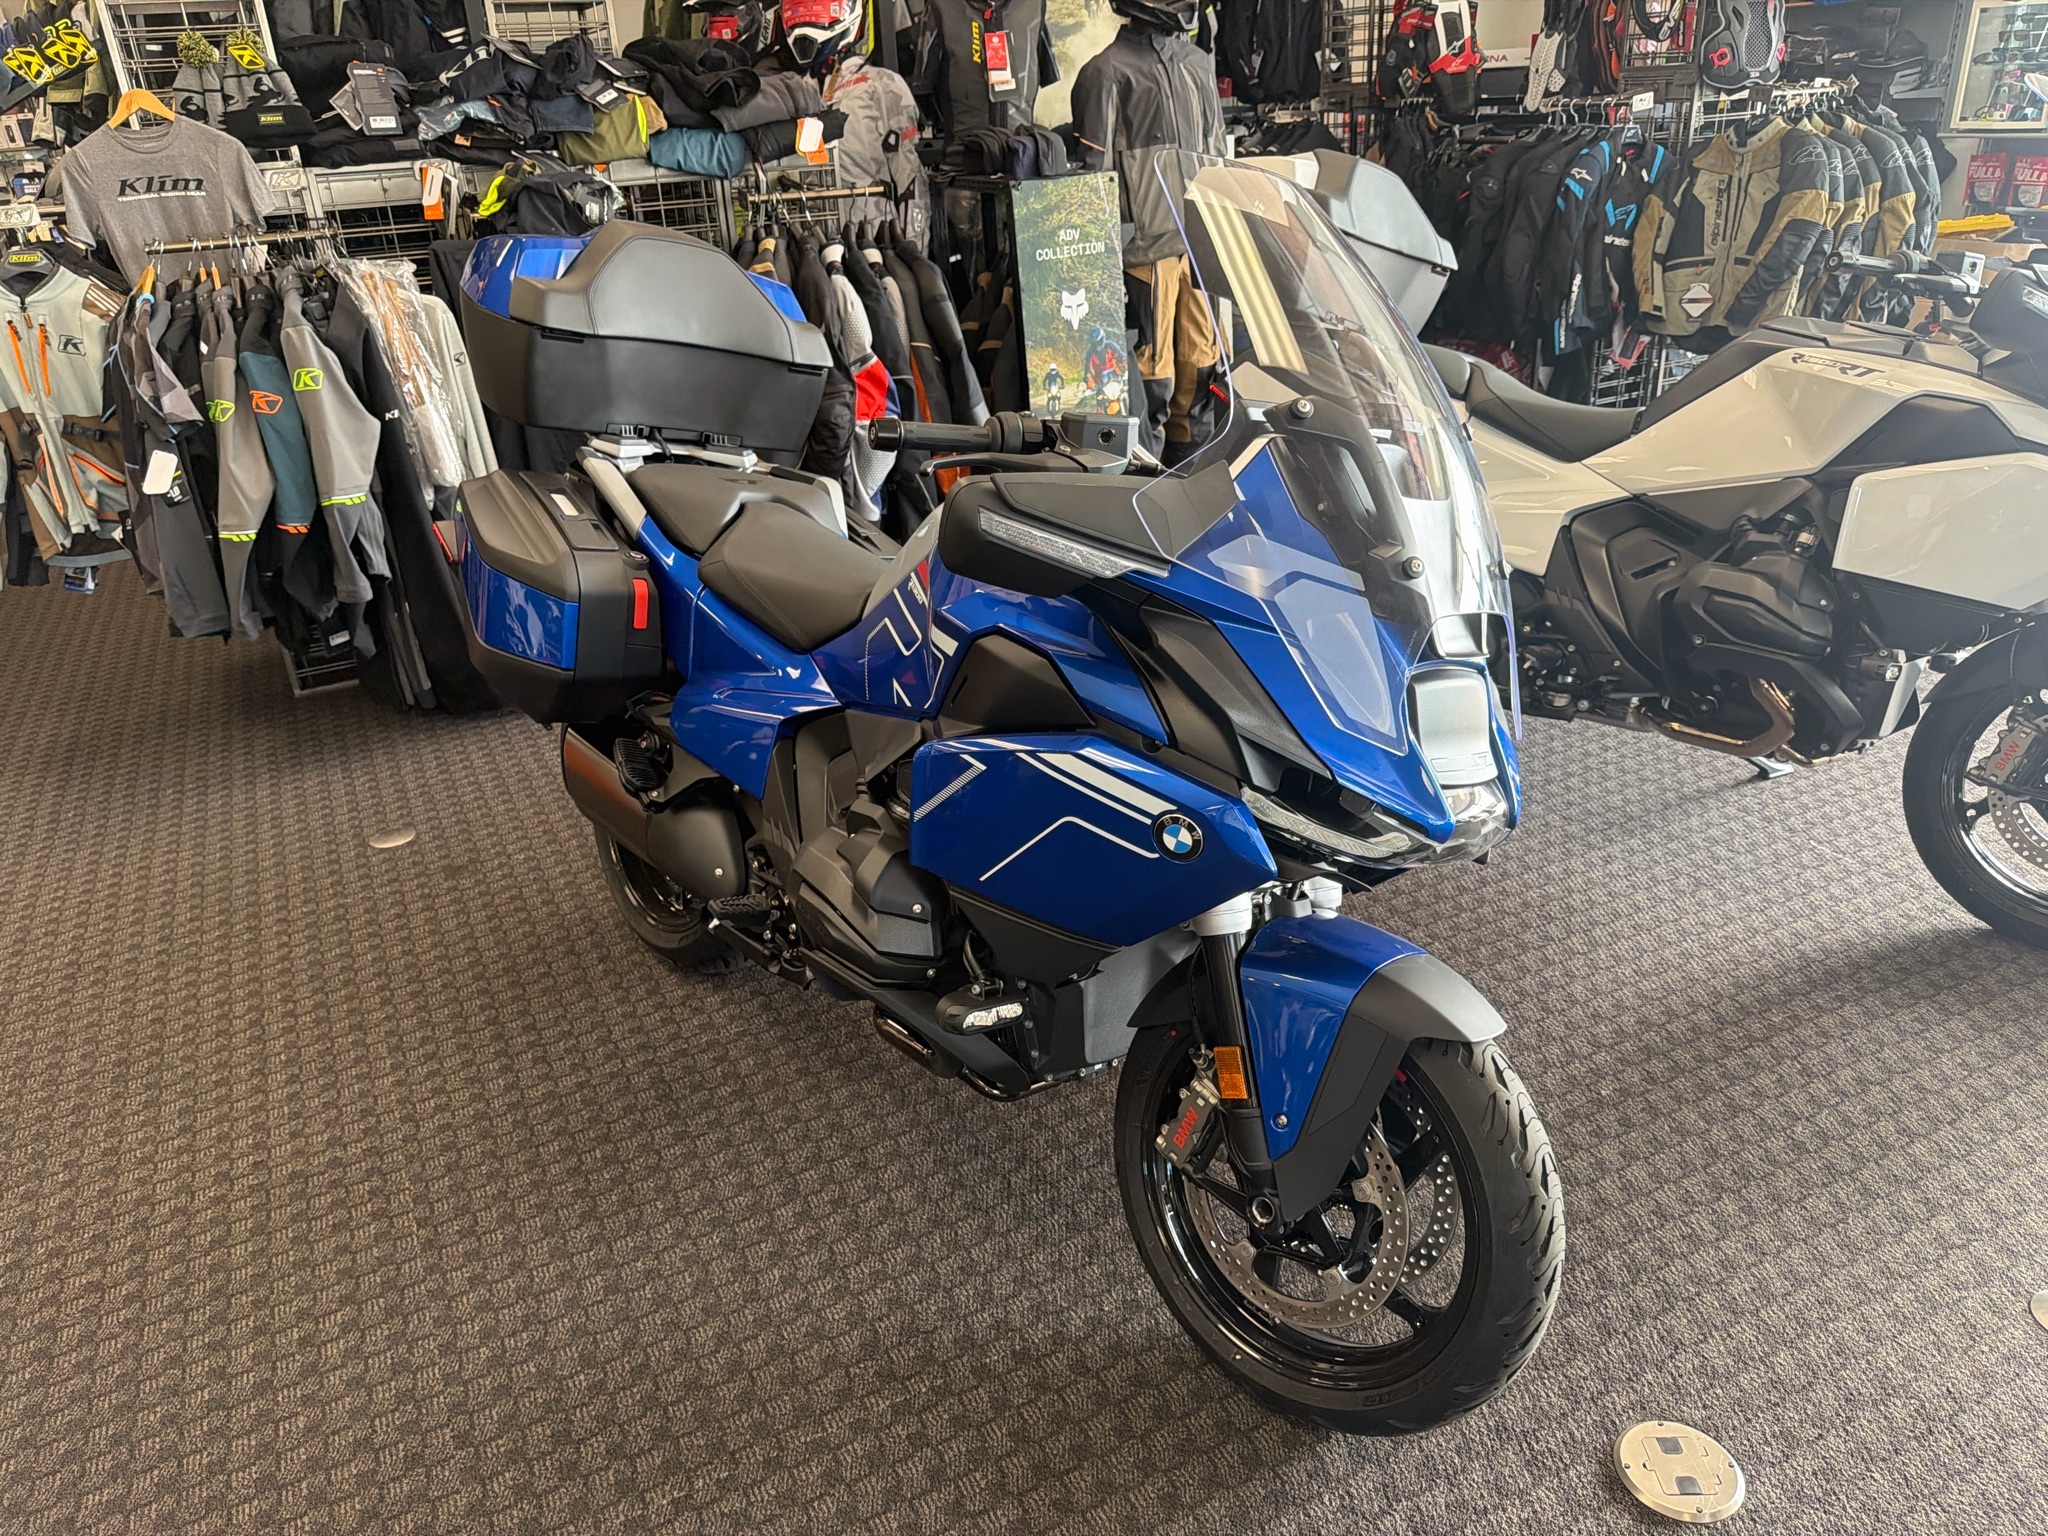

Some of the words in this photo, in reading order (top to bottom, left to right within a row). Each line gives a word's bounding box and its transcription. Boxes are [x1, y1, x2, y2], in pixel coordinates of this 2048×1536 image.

[971, 20, 982, 65] Klim
[117, 175, 205, 197] Klim
[117, 193, 160, 202] TECHNICAL
[1710, 178, 1726, 246] alpinestars
[1059, 228, 1080, 241] ADV
[11, 253, 40, 262] Klim
[1035, 241, 1105, 262] COLLECTION
[1994, 740, 2021, 772] BMW
[1162, 816, 1202, 841] BMW
[1172, 1105, 1199, 1149] BMW
